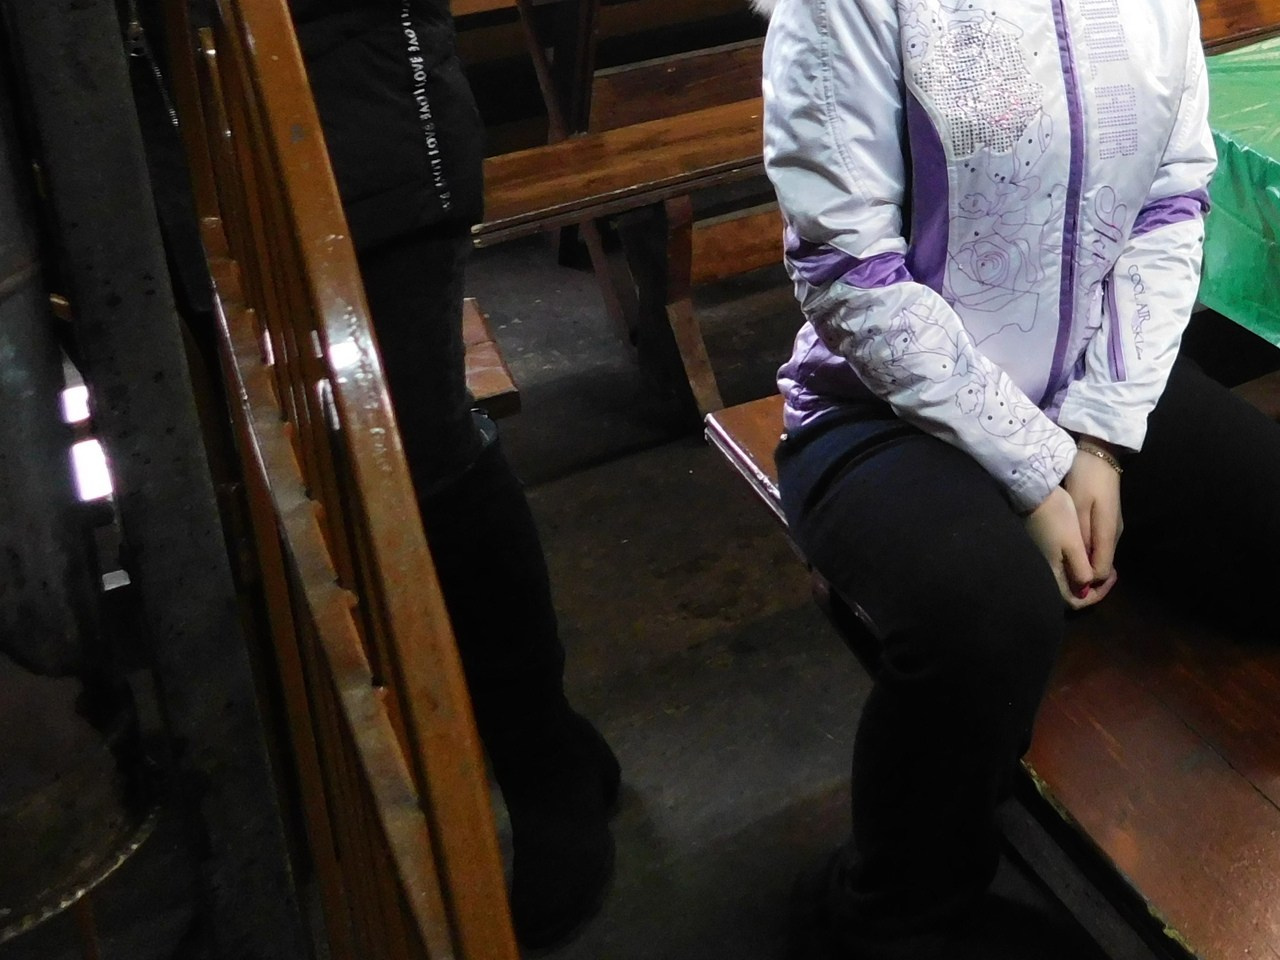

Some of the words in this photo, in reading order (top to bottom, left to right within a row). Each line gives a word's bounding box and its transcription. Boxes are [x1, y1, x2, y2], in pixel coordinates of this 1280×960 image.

[1094, 84, 1139, 160] AIR
[1127, 264, 1145, 300] COOL
[1136, 302, 1151, 323] AIR
[1131, 324, 1144, 344] SKI
